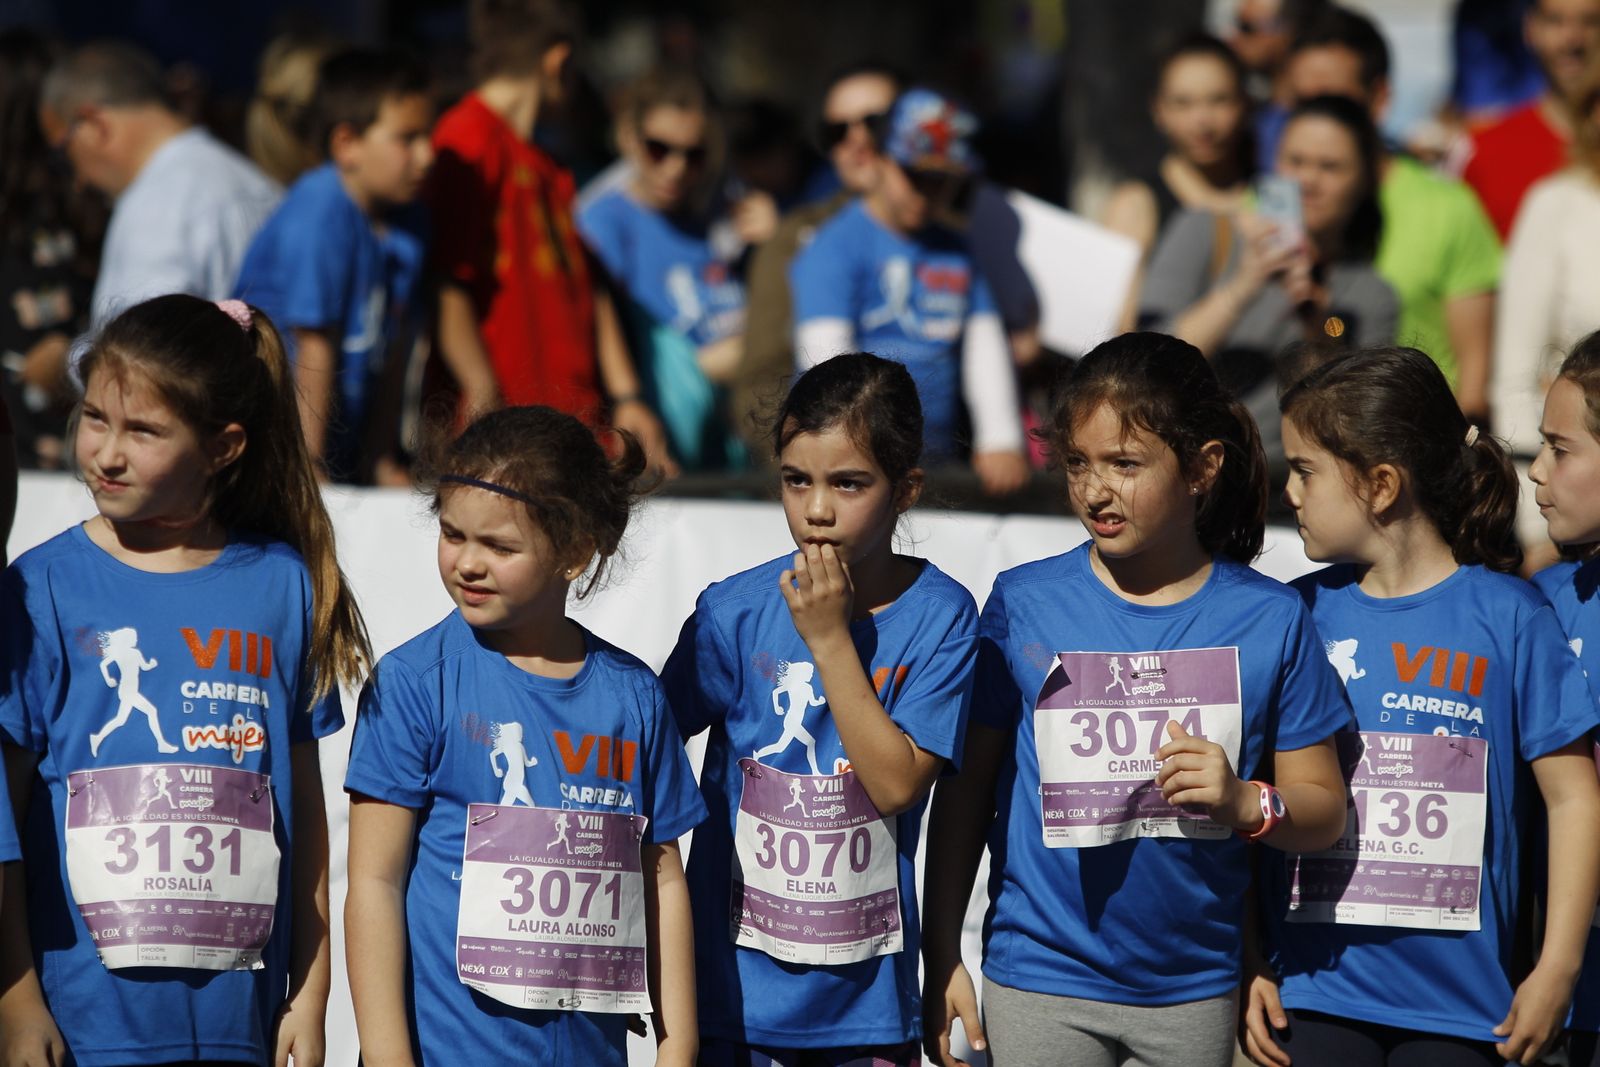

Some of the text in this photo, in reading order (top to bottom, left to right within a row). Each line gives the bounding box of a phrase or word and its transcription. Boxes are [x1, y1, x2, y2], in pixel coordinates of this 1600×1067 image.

[180, 627, 272, 679] VIII
[1128, 655, 1162, 671] VIII
[1391, 642, 1488, 697] VIII
[180, 681, 270, 709] CARRERA
[1381, 692, 1484, 724] CARRERA
[182, 713, 265, 764] mujer
[1070, 708, 1208, 757] 3074
[1380, 736, 1413, 752] VIII
[553, 730, 639, 783] VIII
[1378, 753, 1414, 761] CARRERA
[1107, 759, 1168, 773] CARME
[179, 768, 213, 785] VIII
[1369, 778, 1380, 786] ES
[1381, 779, 1419, 788] NUESTRA
[179, 786, 214, 794] CARRERA
[812, 778, 844, 793] VIII
[560, 782, 635, 809] CARRERA
[183, 813, 221, 821] NUESTRA
[759, 811, 767, 819] LA
[766, 814, 801, 827] IGUALDAD
[815, 819, 851, 828] NUESTRA
[850, 814, 868, 826] META
[1067, 806, 1088, 818] CDX
[1351, 789, 1449, 840] 136
[577, 815, 604, 831] VIII
[575, 832, 604, 840] CARRERA
[104, 825, 242, 877] 3131
[755, 823, 872, 878] 3070
[1391, 841, 1424, 856] G.C.
[522, 855, 565, 865] IGUALDAD
[566, 858, 576, 866] ES
[577, 860, 607, 868] NUESTRA
[143, 875, 213, 892] ROSALÍA
[785, 879, 837, 895] ELENA
[499, 866, 622, 920] 3071
[508, 918, 616, 938] LAURA ALONSO
[460, 963, 486, 975] NEXA
[489, 965, 512, 976] CDX
